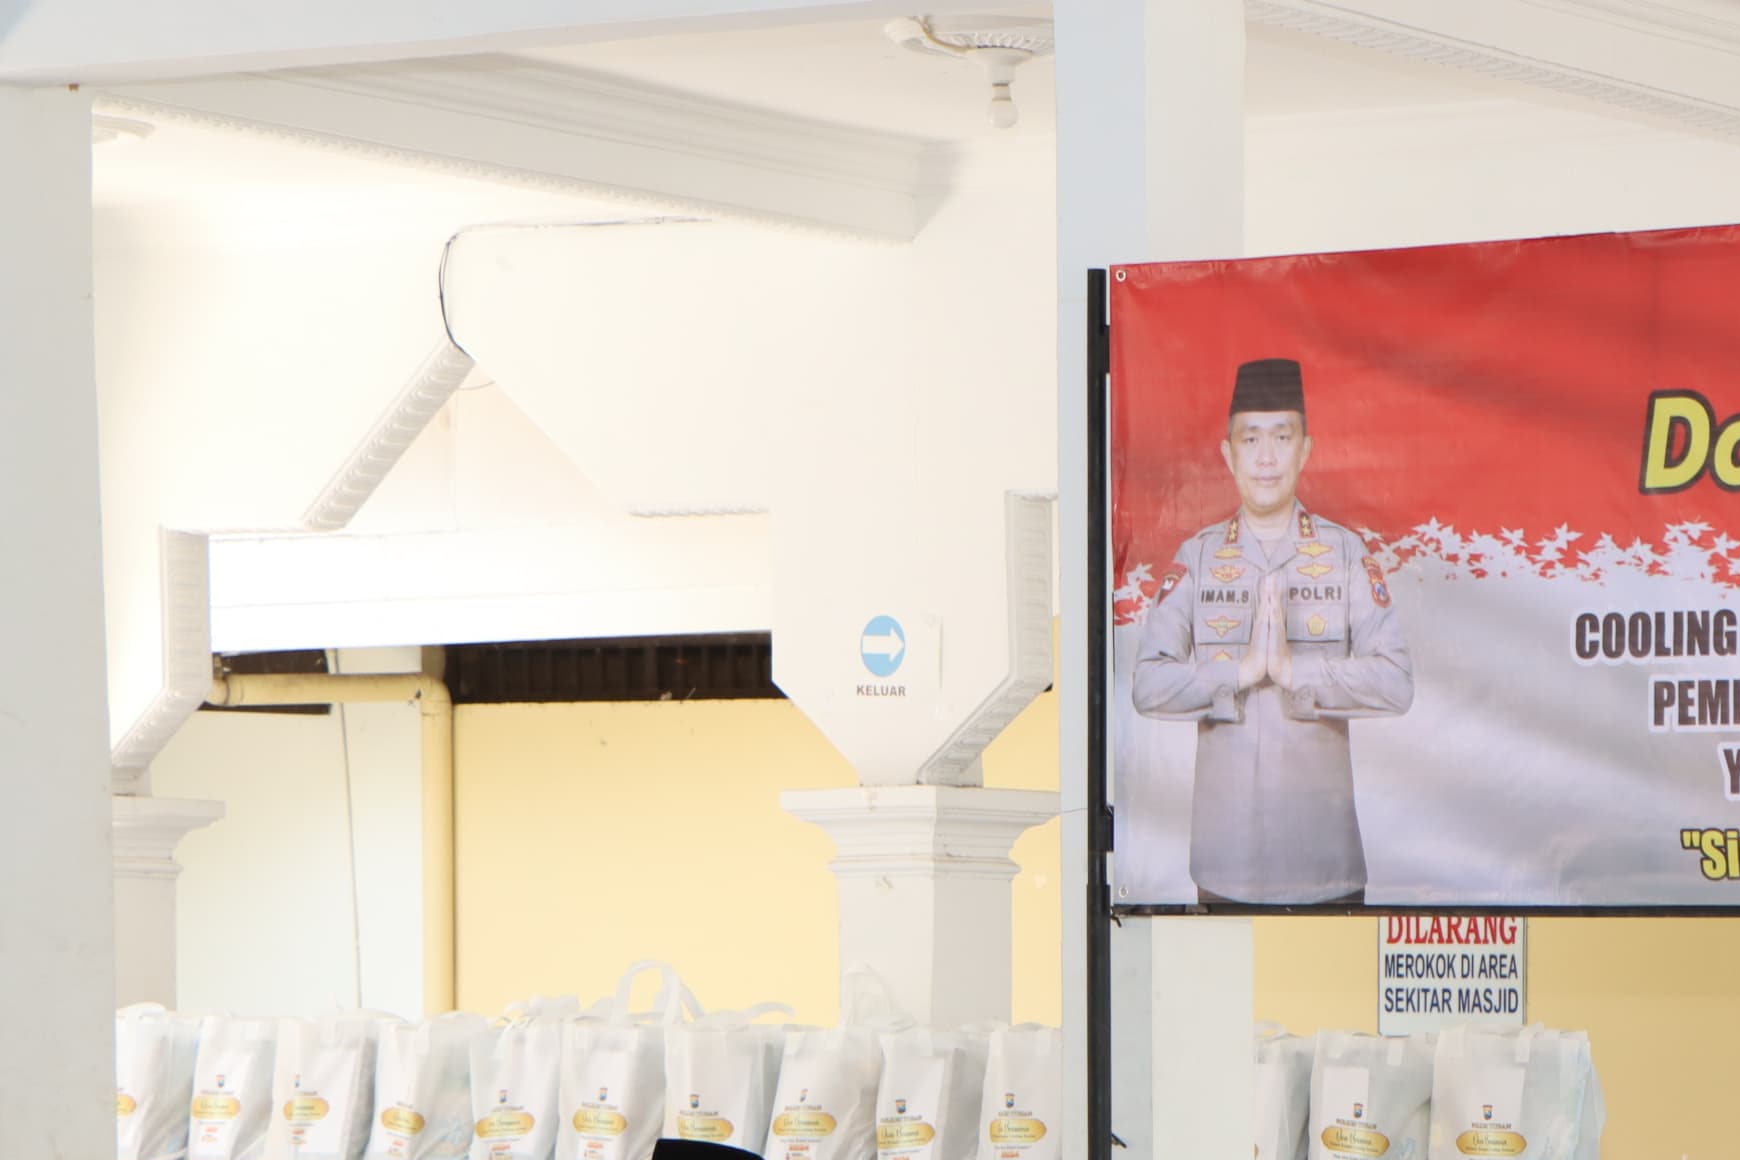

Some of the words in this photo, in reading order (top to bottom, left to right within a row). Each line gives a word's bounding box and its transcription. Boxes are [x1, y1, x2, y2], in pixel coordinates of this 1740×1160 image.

[1289, 586, 1342, 600] POLRI
[1575, 609, 1737, 660] COOLING
[856, 684, 906, 697] KELUAR
[1386, 915, 1517, 945] DILARANG
[1384, 953, 1456, 979] MEROKOK
[1461, 953, 1474, 979] DI
[1478, 953, 1518, 979] AREA
[1384, 987, 1452, 1013] SEKITAR
[1458, 988, 1519, 1013] MASJID
